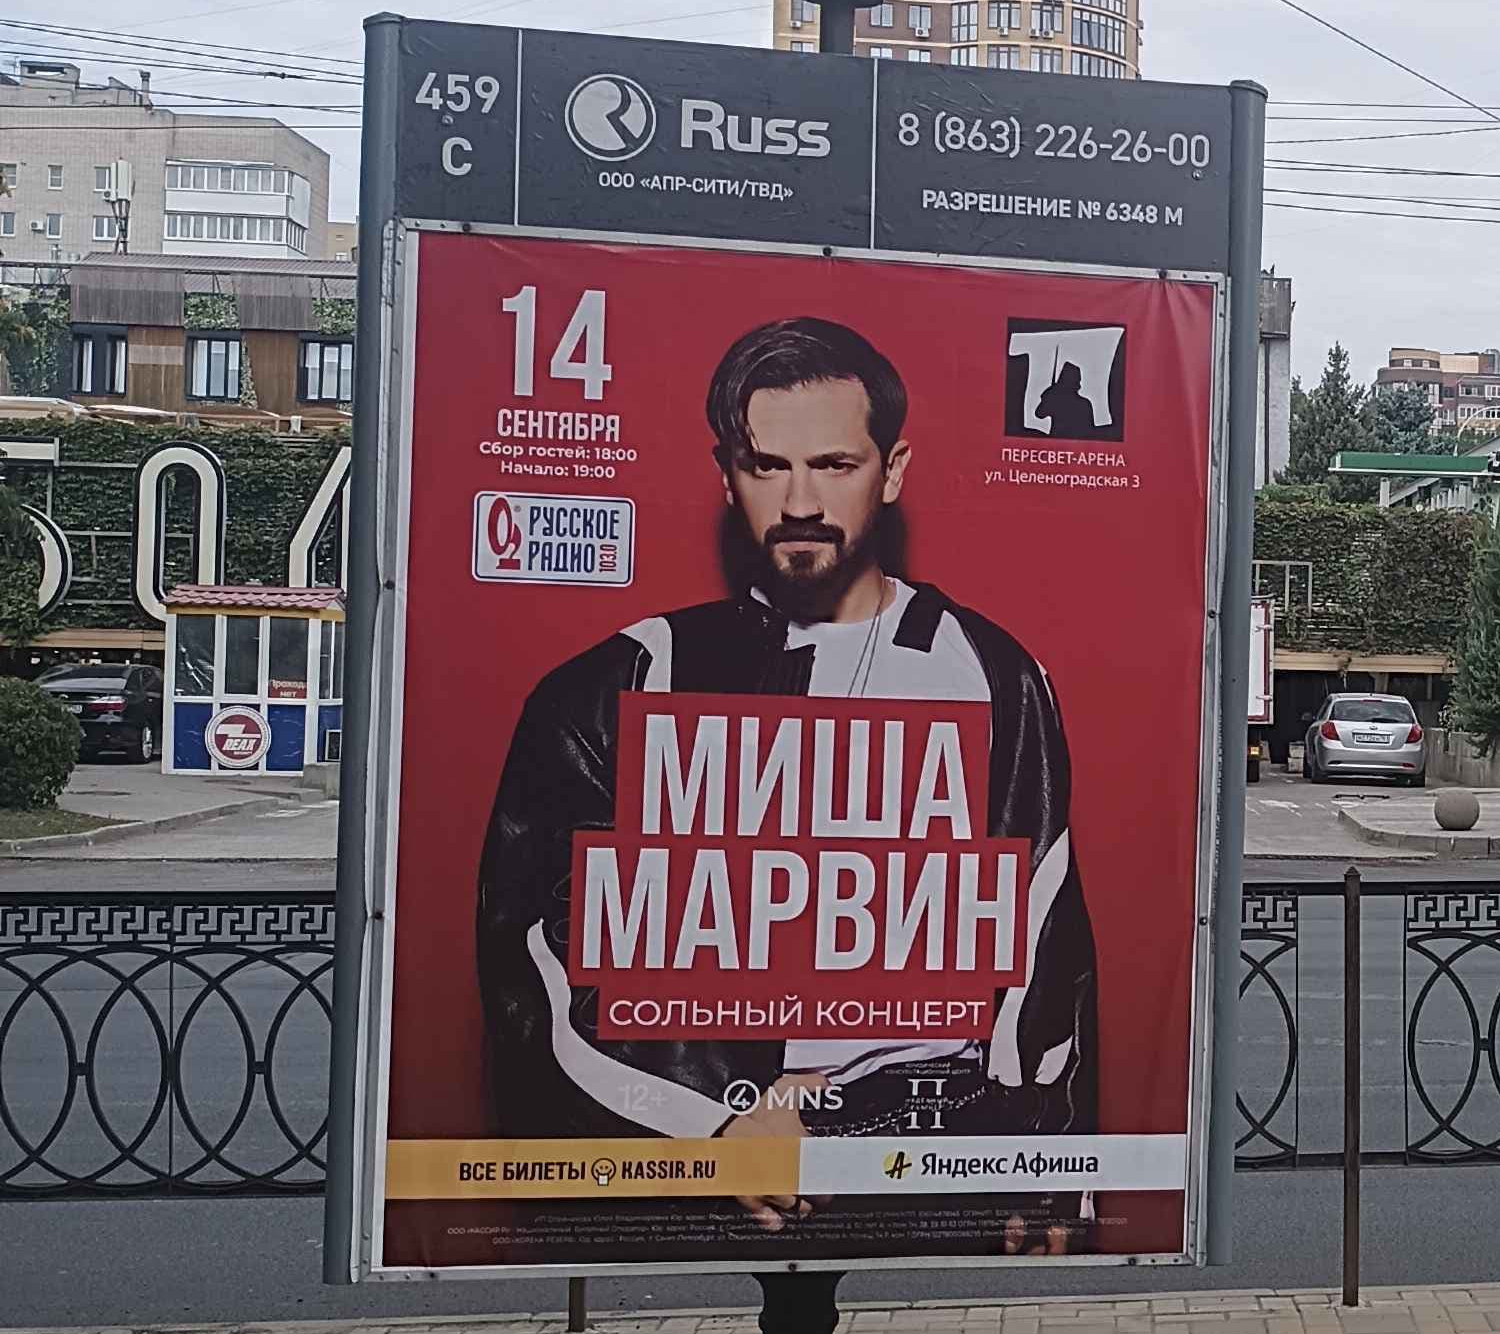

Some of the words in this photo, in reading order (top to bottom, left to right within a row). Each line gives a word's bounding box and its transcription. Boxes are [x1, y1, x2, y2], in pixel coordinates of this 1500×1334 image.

[415, 72, 500, 114] 459
[681, 98, 831, 157] Russ
[898, 112, 920, 147] 8
[934, 110, 1021, 158] (863)
[1034, 123, 1210, 168] 226-26-00
[599, 172, 635, 188] ООО
[640, 175, 794, 201] «АПР-СИТИ/ТВД»
[922, 189, 1072, 219] РАЗРЕШЕНИЕ
[1078, 200, 1101, 219] №
[1105, 202, 1159, 225] 6348
[502, 285, 612, 401] 14
[497, 408, 620, 443] СЕНТЯБРЯ
[480, 441, 524, 460] Сбор
[528, 444, 591, 460] гостей:
[594, 447, 637, 462] 18:00
[1001, 448, 1126, 467] ПЕРЕСВЕТ-АРЕНА
[501, 462, 569, 478] Начало:
[573, 464, 616, 479] 19:00
[985, 470, 1005, 485] ул.
[528, 505, 620, 541] РУССКОЕ
[527, 540, 596, 574] РАДИО
[599, 543, 618, 573] 103.0
[641, 714, 973, 841] МИША
[581, 847, 1019, 973] МАРВИН
[609, 994, 804, 1028] СОЛЬНЫЙ
[816, 999, 987, 1031] КОНЦЕРТ
[617, 1084, 668, 1111] 12+
[767, 1084, 843, 1111] MNS
[459, 1162, 496, 1182] ВСЕ
[502, 1161, 588, 1182] БИЛЕТЫ
[620, 1160, 716, 1181] KASSIR.RU
[920, 1153, 1007, 1177] Яндекс
[1012, 1153, 1099, 1176] Афиша
